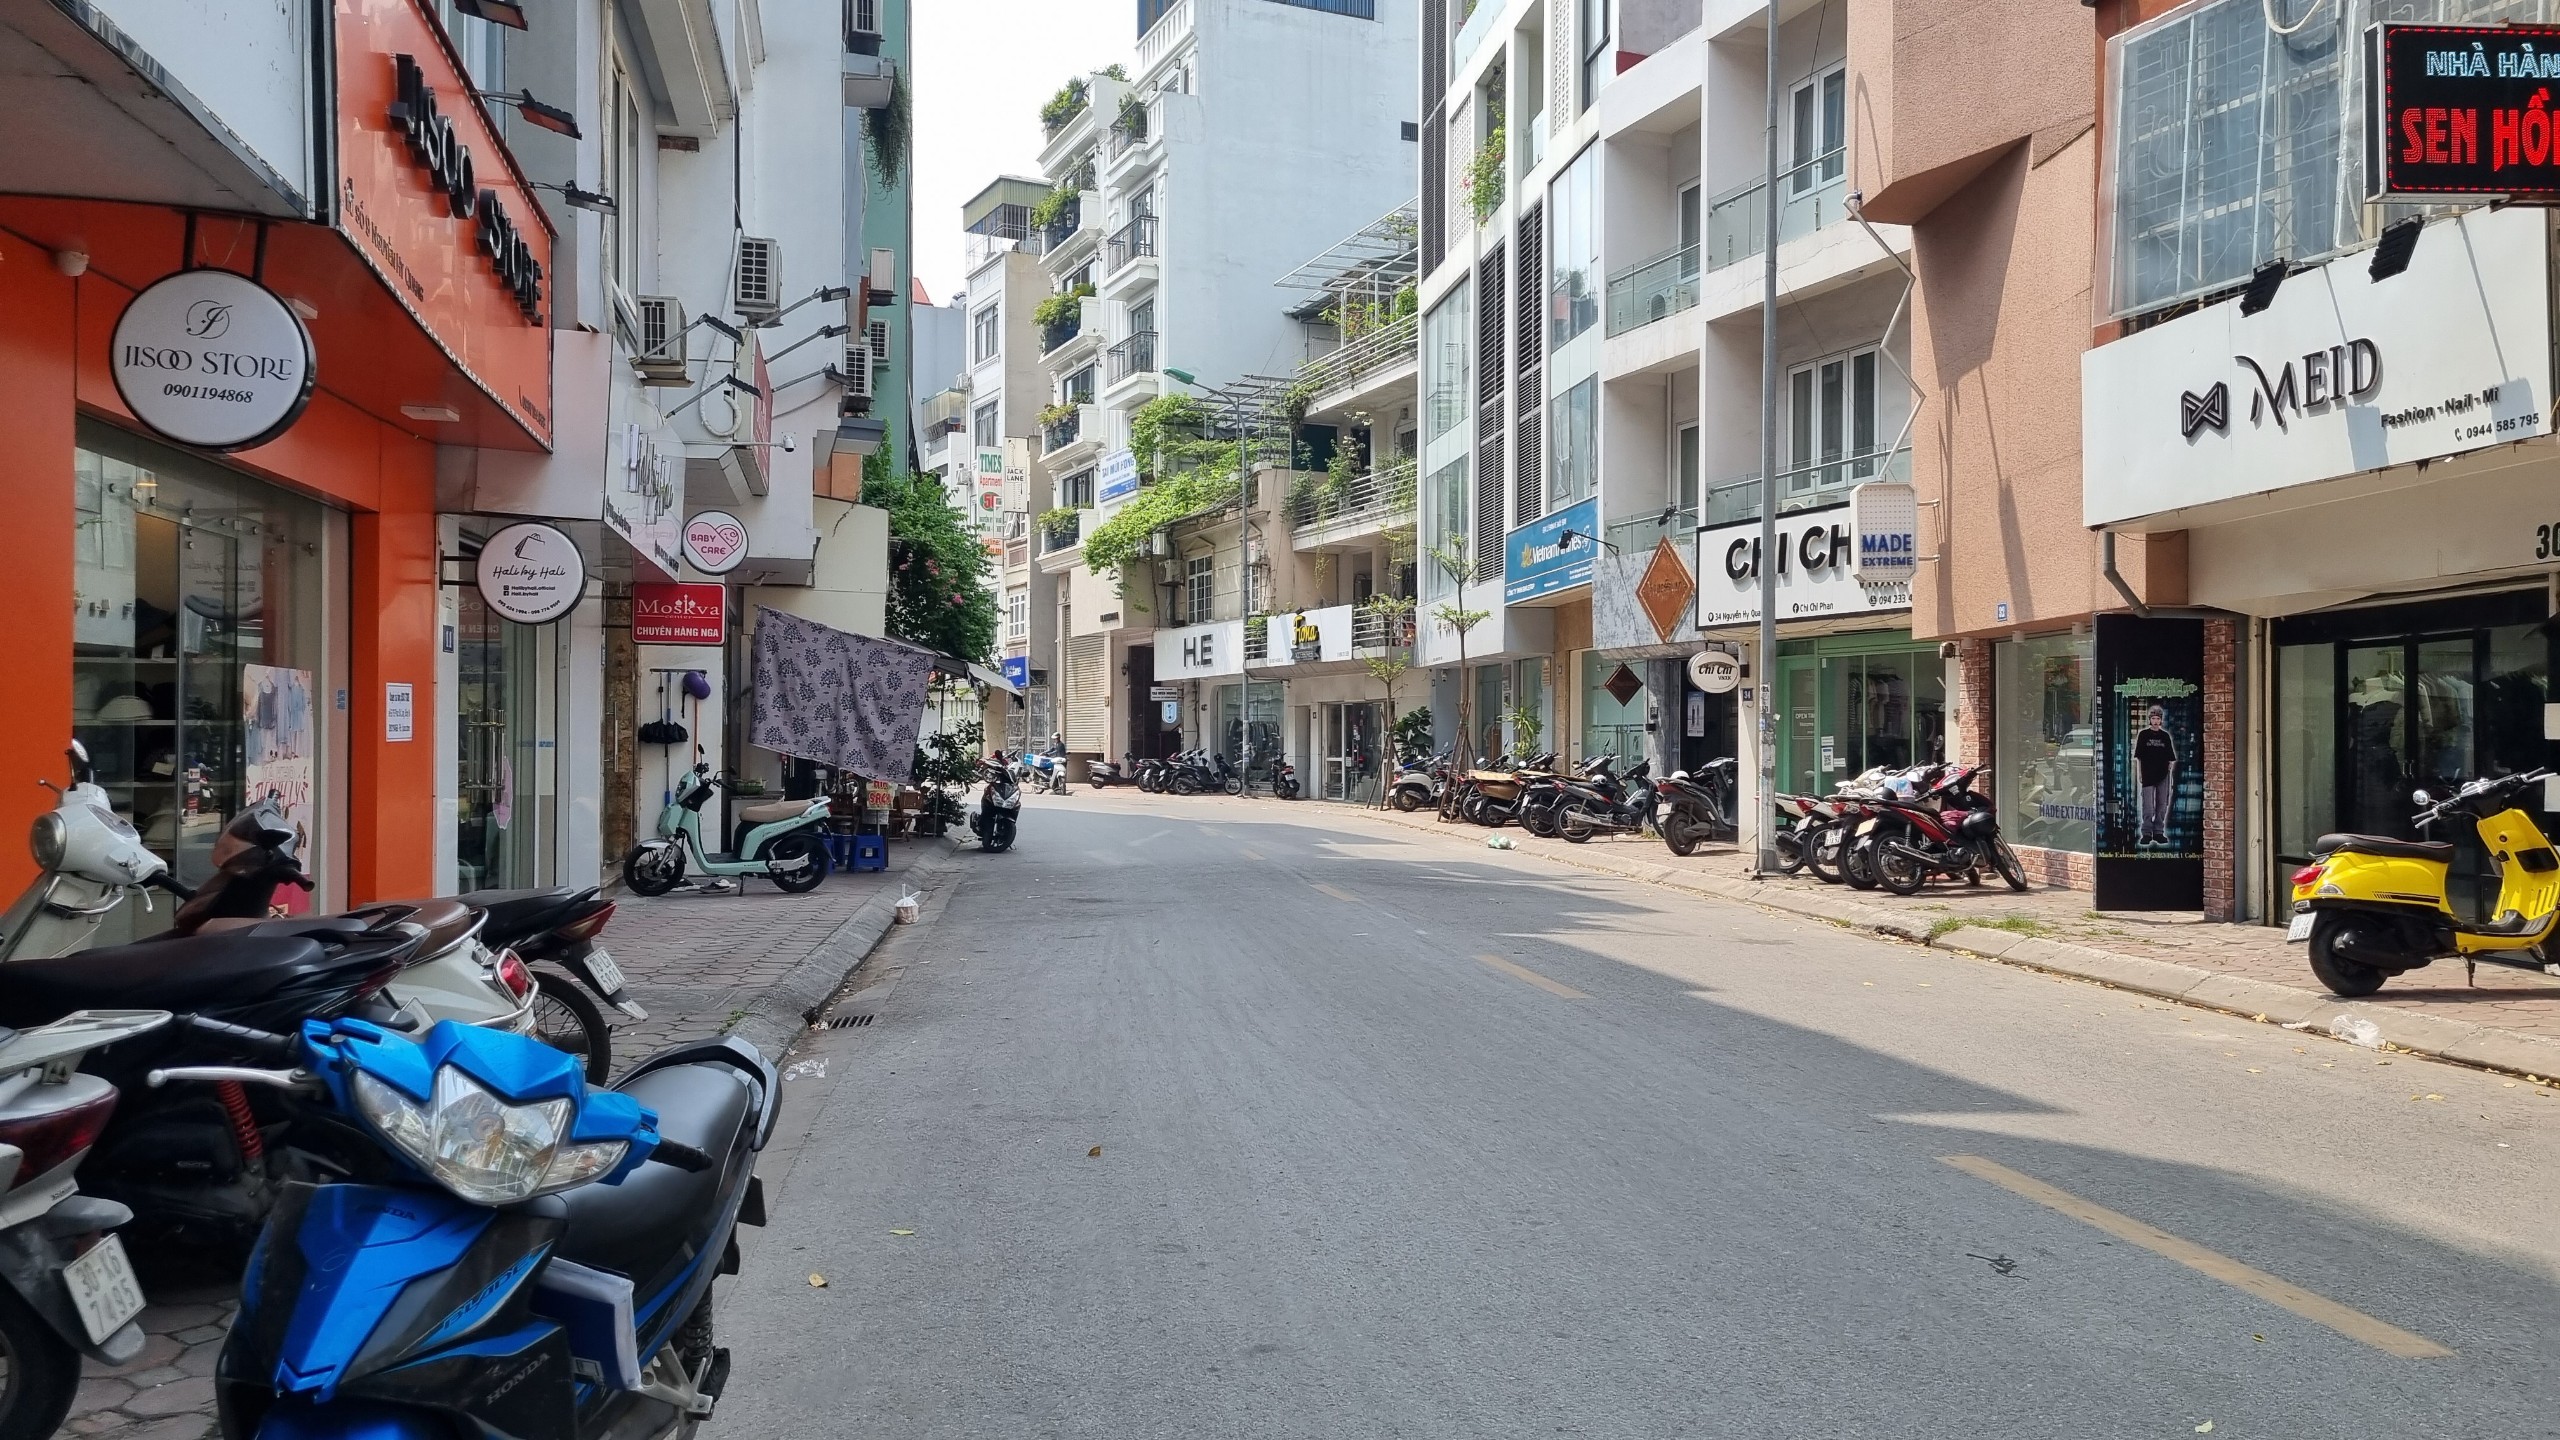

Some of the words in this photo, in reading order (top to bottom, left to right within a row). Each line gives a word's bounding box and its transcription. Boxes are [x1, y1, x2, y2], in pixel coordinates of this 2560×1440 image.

[2426, 41, 2490, 76] NHÀ
[2402, 108, 2477, 164] SEN
[124, 345, 193, 371] JISOO
[201, 351, 292, 381] STORE
[163, 383, 254, 404] 0901194868
[2381, 406, 2433, 428] Fashion
[2444, 394, 2473, 412] Nail
[2482, 387, 2499, 403] Mi
[2466, 423, 2493, 439] 0944
[2496, 418, 2516, 432] 585
[2519, 413, 2539, 428] 795
[980, 453, 1002, 473] TIMES
[691, 533, 717, 543] BABY
[1861, 533, 1912, 553] MADE
[701, 546, 726, 555] CARE
[1861, 556, 1913, 567] EXTREME
[492, 564, 519, 580] Hali
[520, 564, 537, 580] by
[540, 565, 566, 580] Hali
[637, 595, 720, 616] Moskva
[1800, 603, 1808, 612] Chi
[1810, 602, 1818, 612] Chi
[1820, 602, 1834, 611] Phan
[1879, 594, 1892, 605] 094
[1893, 593, 1906, 604] 233
[1742, 610, 1750, 620] Hy
[636, 626, 672, 636] CHUYÊN
[674, 626, 698, 637] HÀNG
[700, 628, 719, 638] NGA
[1698, 664, 1715, 675] Chi
[1744, 692, 1751, 700] 34
[2040, 804, 2060, 818] MADE
[486, 1352, 550, 1406] HONDA
